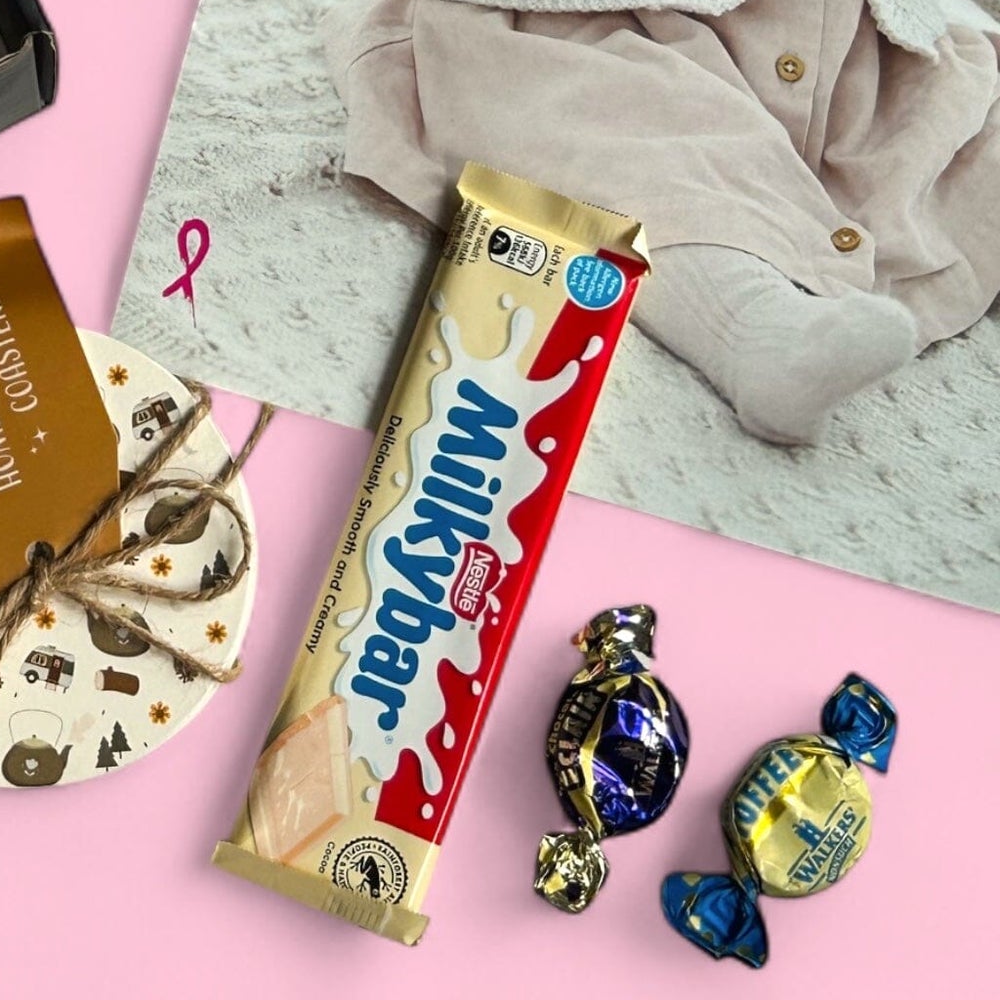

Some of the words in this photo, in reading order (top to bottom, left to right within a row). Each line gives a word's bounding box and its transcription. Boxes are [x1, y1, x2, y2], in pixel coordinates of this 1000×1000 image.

[525, 243, 543, 270] Energy
[543, 268, 558, 286] bar
[550, 245, 565, 266] Each
[363, 414, 403, 494] Deliciously
[345, 498, 373, 557] Smooth
[329, 558, 347, 591] and
[351, 379, 518, 731] Milkybar
[304, 593, 337, 654] Creamy
